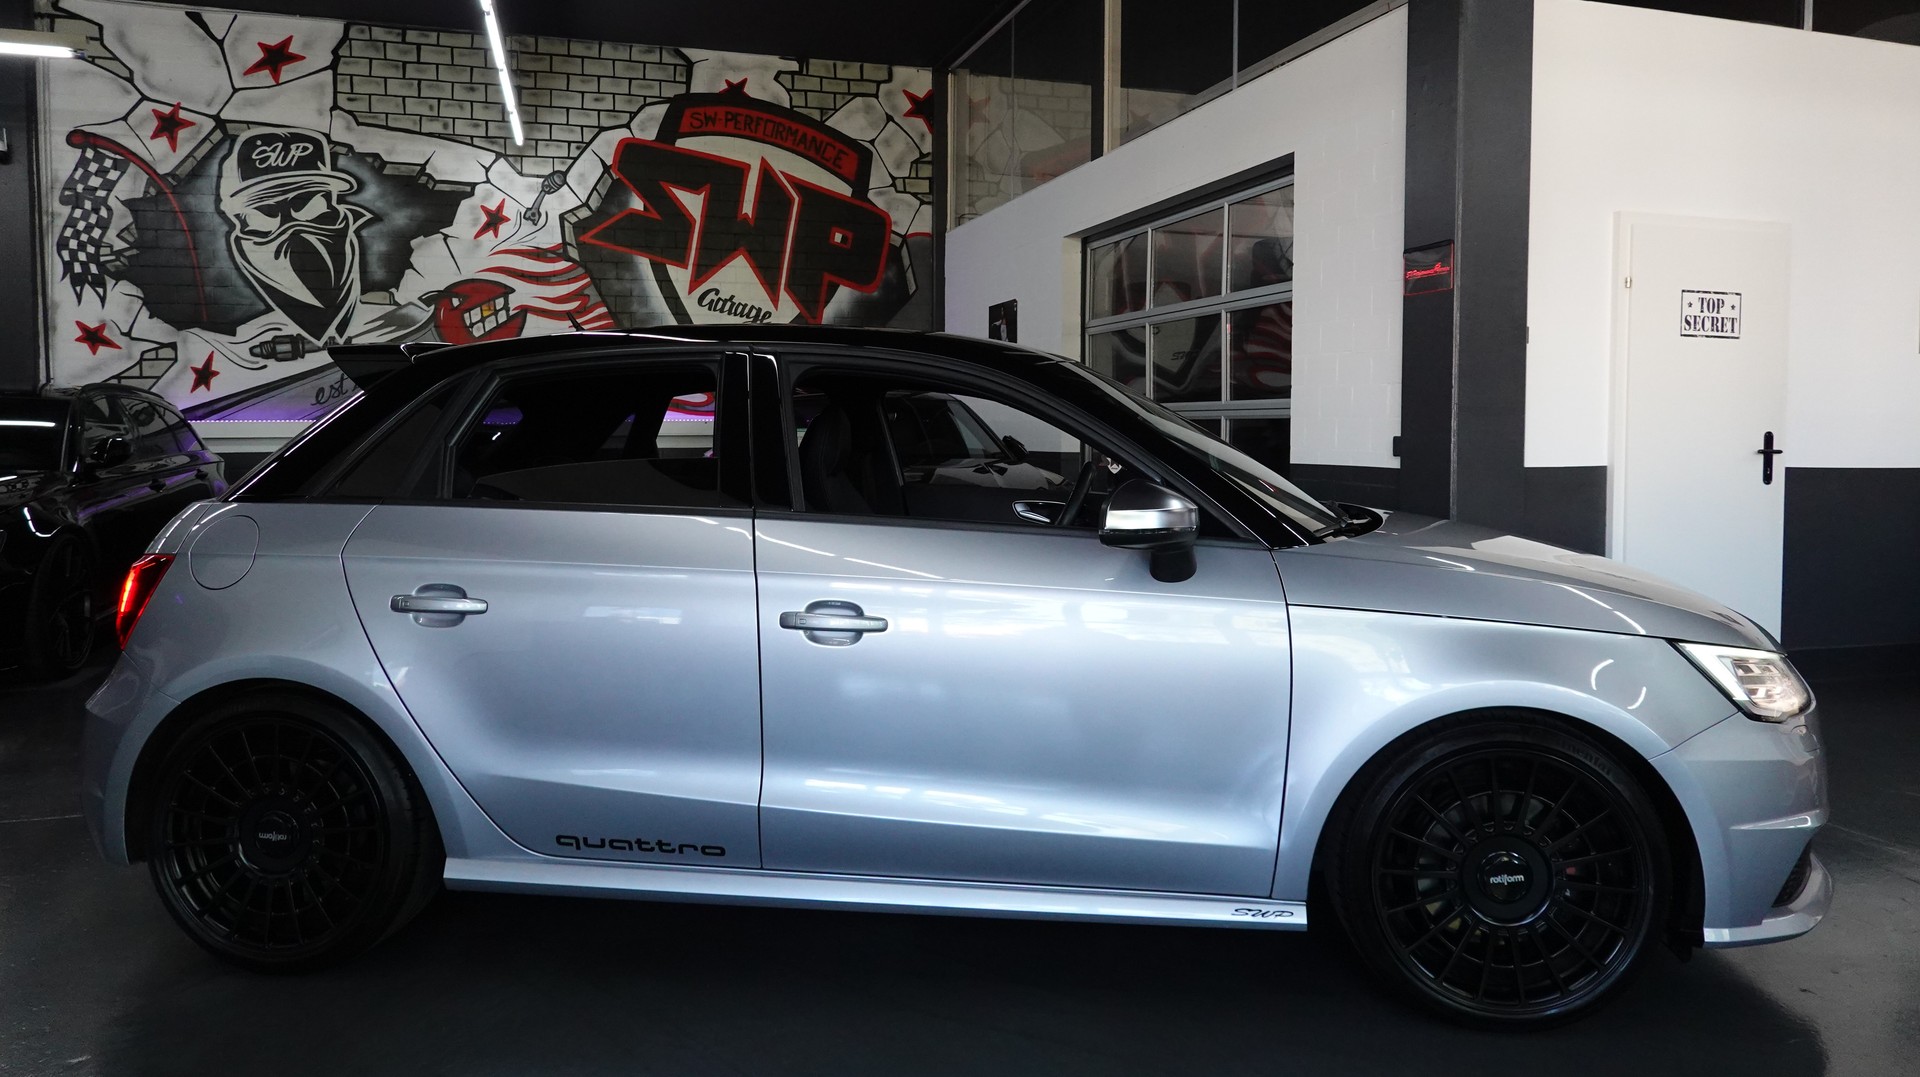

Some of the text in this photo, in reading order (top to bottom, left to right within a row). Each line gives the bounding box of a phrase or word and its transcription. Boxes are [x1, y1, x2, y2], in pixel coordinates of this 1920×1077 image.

[689, 111, 850, 170] SW-PERFORMANCE
[252, 142, 314, 168] SWP
[580, 137, 892, 324] SWP
[697, 288, 773, 324] Garage
[1698, 297, 1725, 314] TOP
[1683, 314, 1738, 333] SECRET
[555, 834, 726, 857] quattro
[1489, 873, 1525, 886] rotiform
[1231, 908, 1294, 918] SWP
